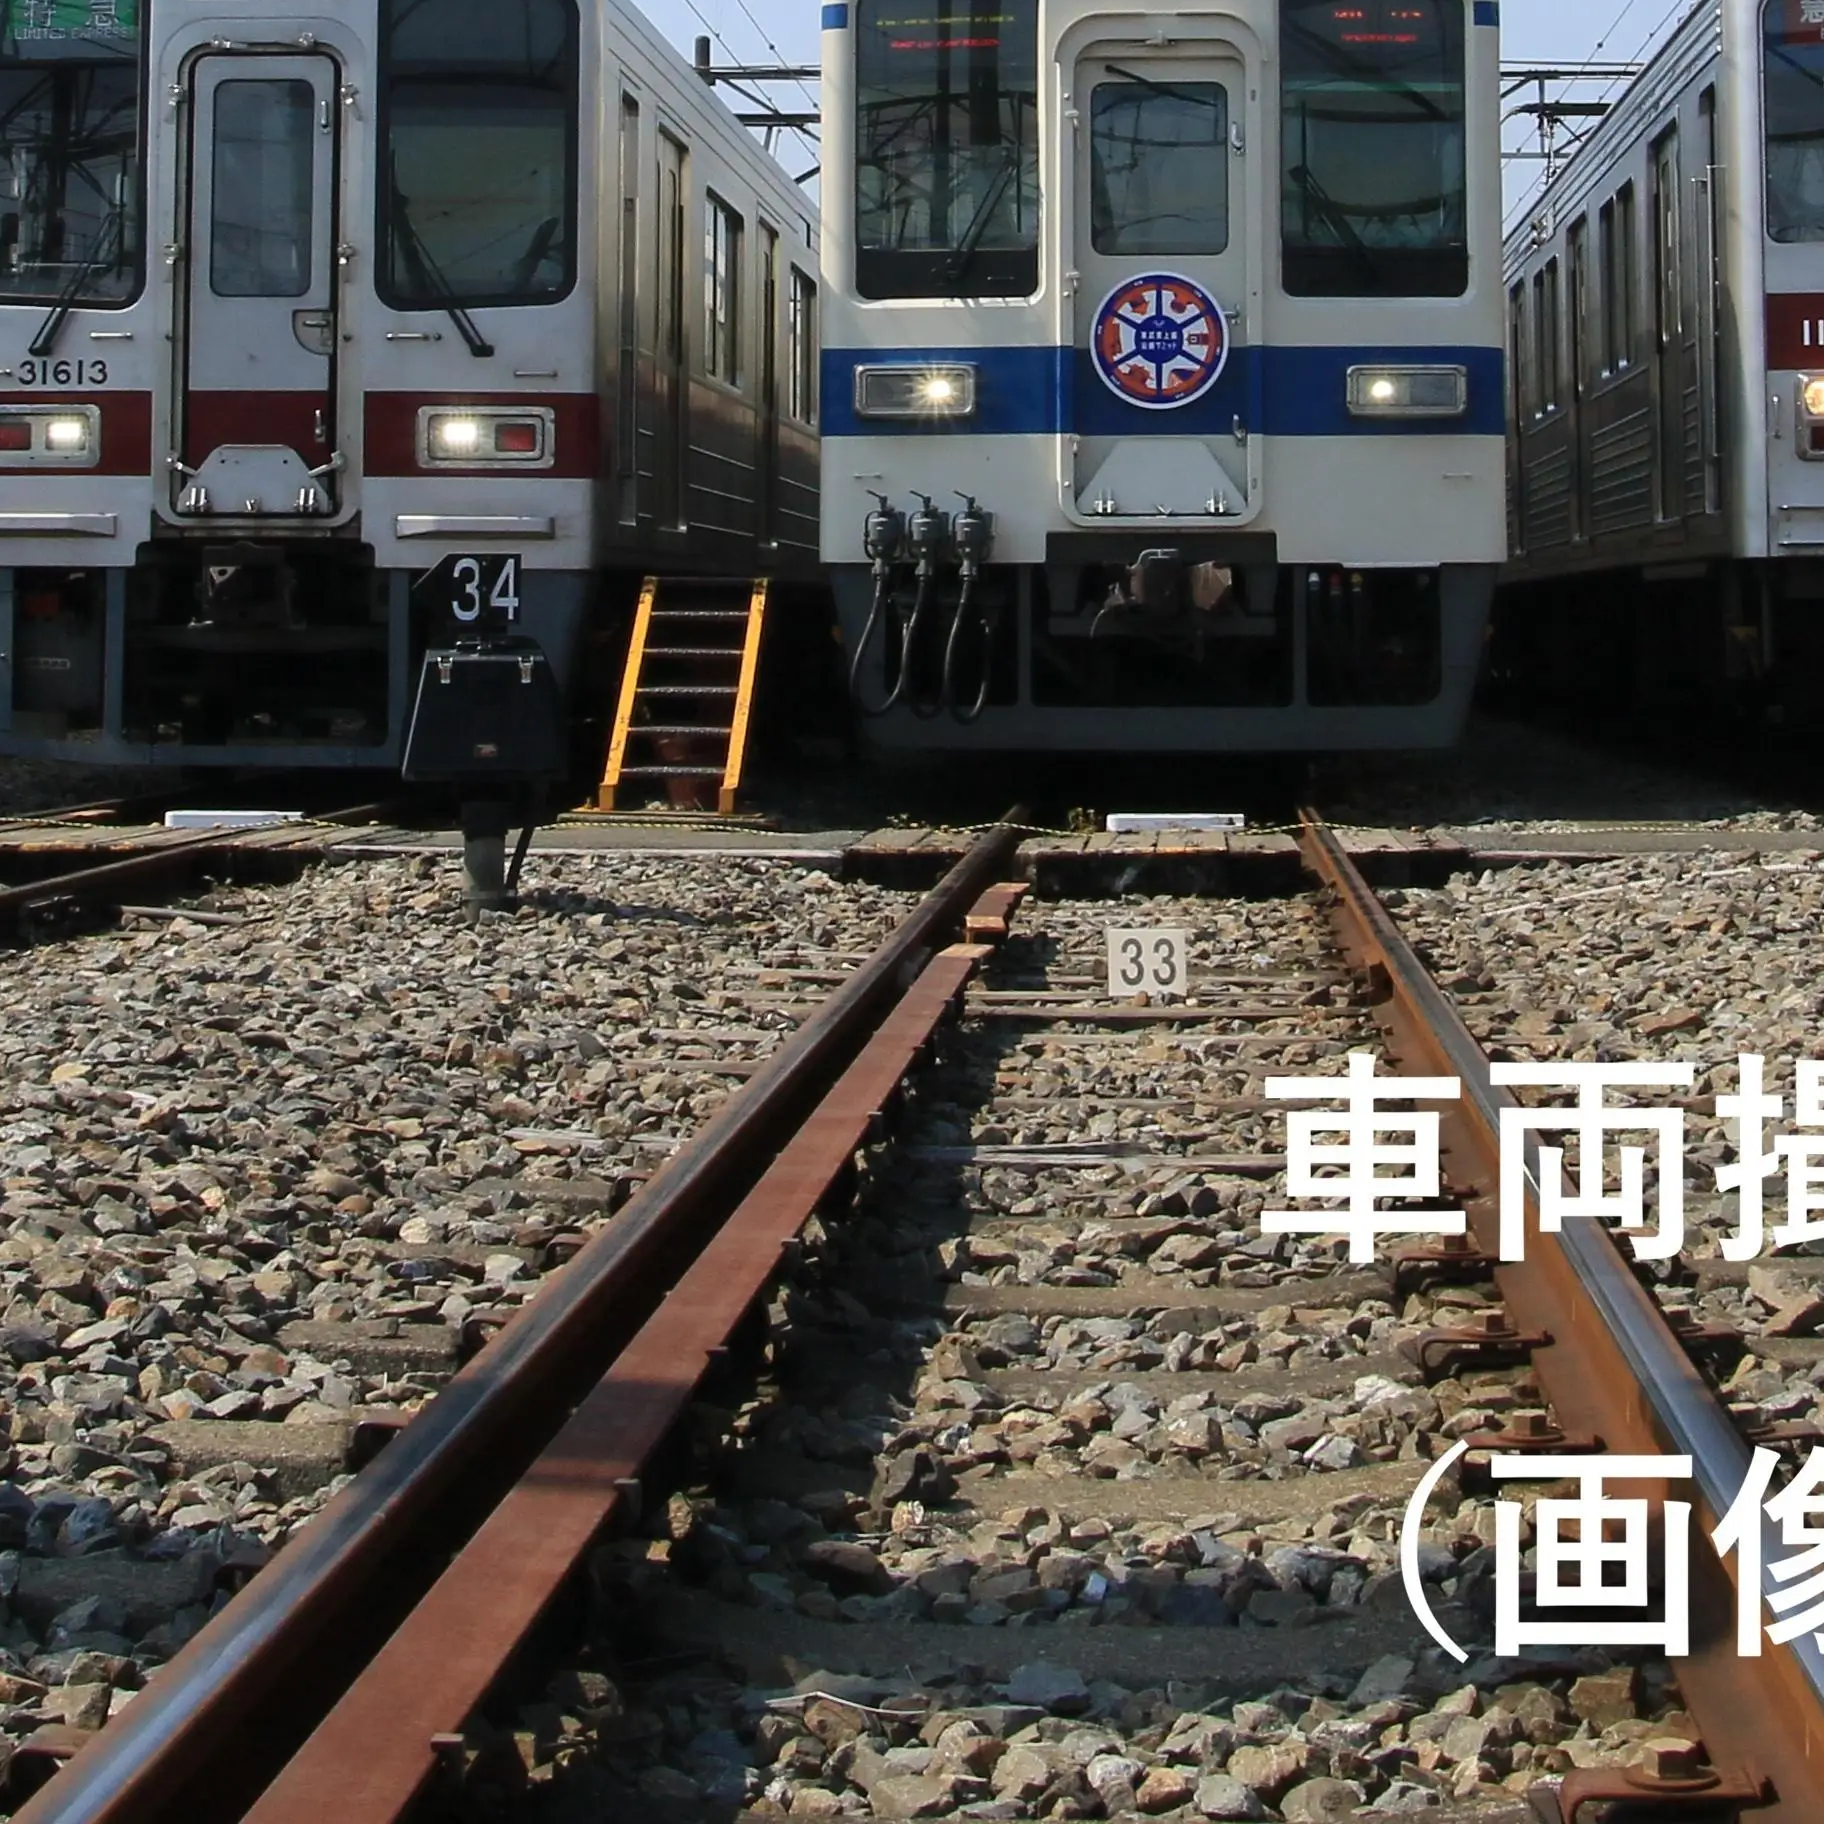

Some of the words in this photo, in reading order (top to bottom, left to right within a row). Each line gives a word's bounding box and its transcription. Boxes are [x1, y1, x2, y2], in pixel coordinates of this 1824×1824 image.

[14, 28, 65, 40] LIMITED
[71, 27, 128, 40] EXPRESS
[18, 360, 108, 385] 31613
[452, 558, 519, 621] 34
[1120, 938, 1177, 986] 33
